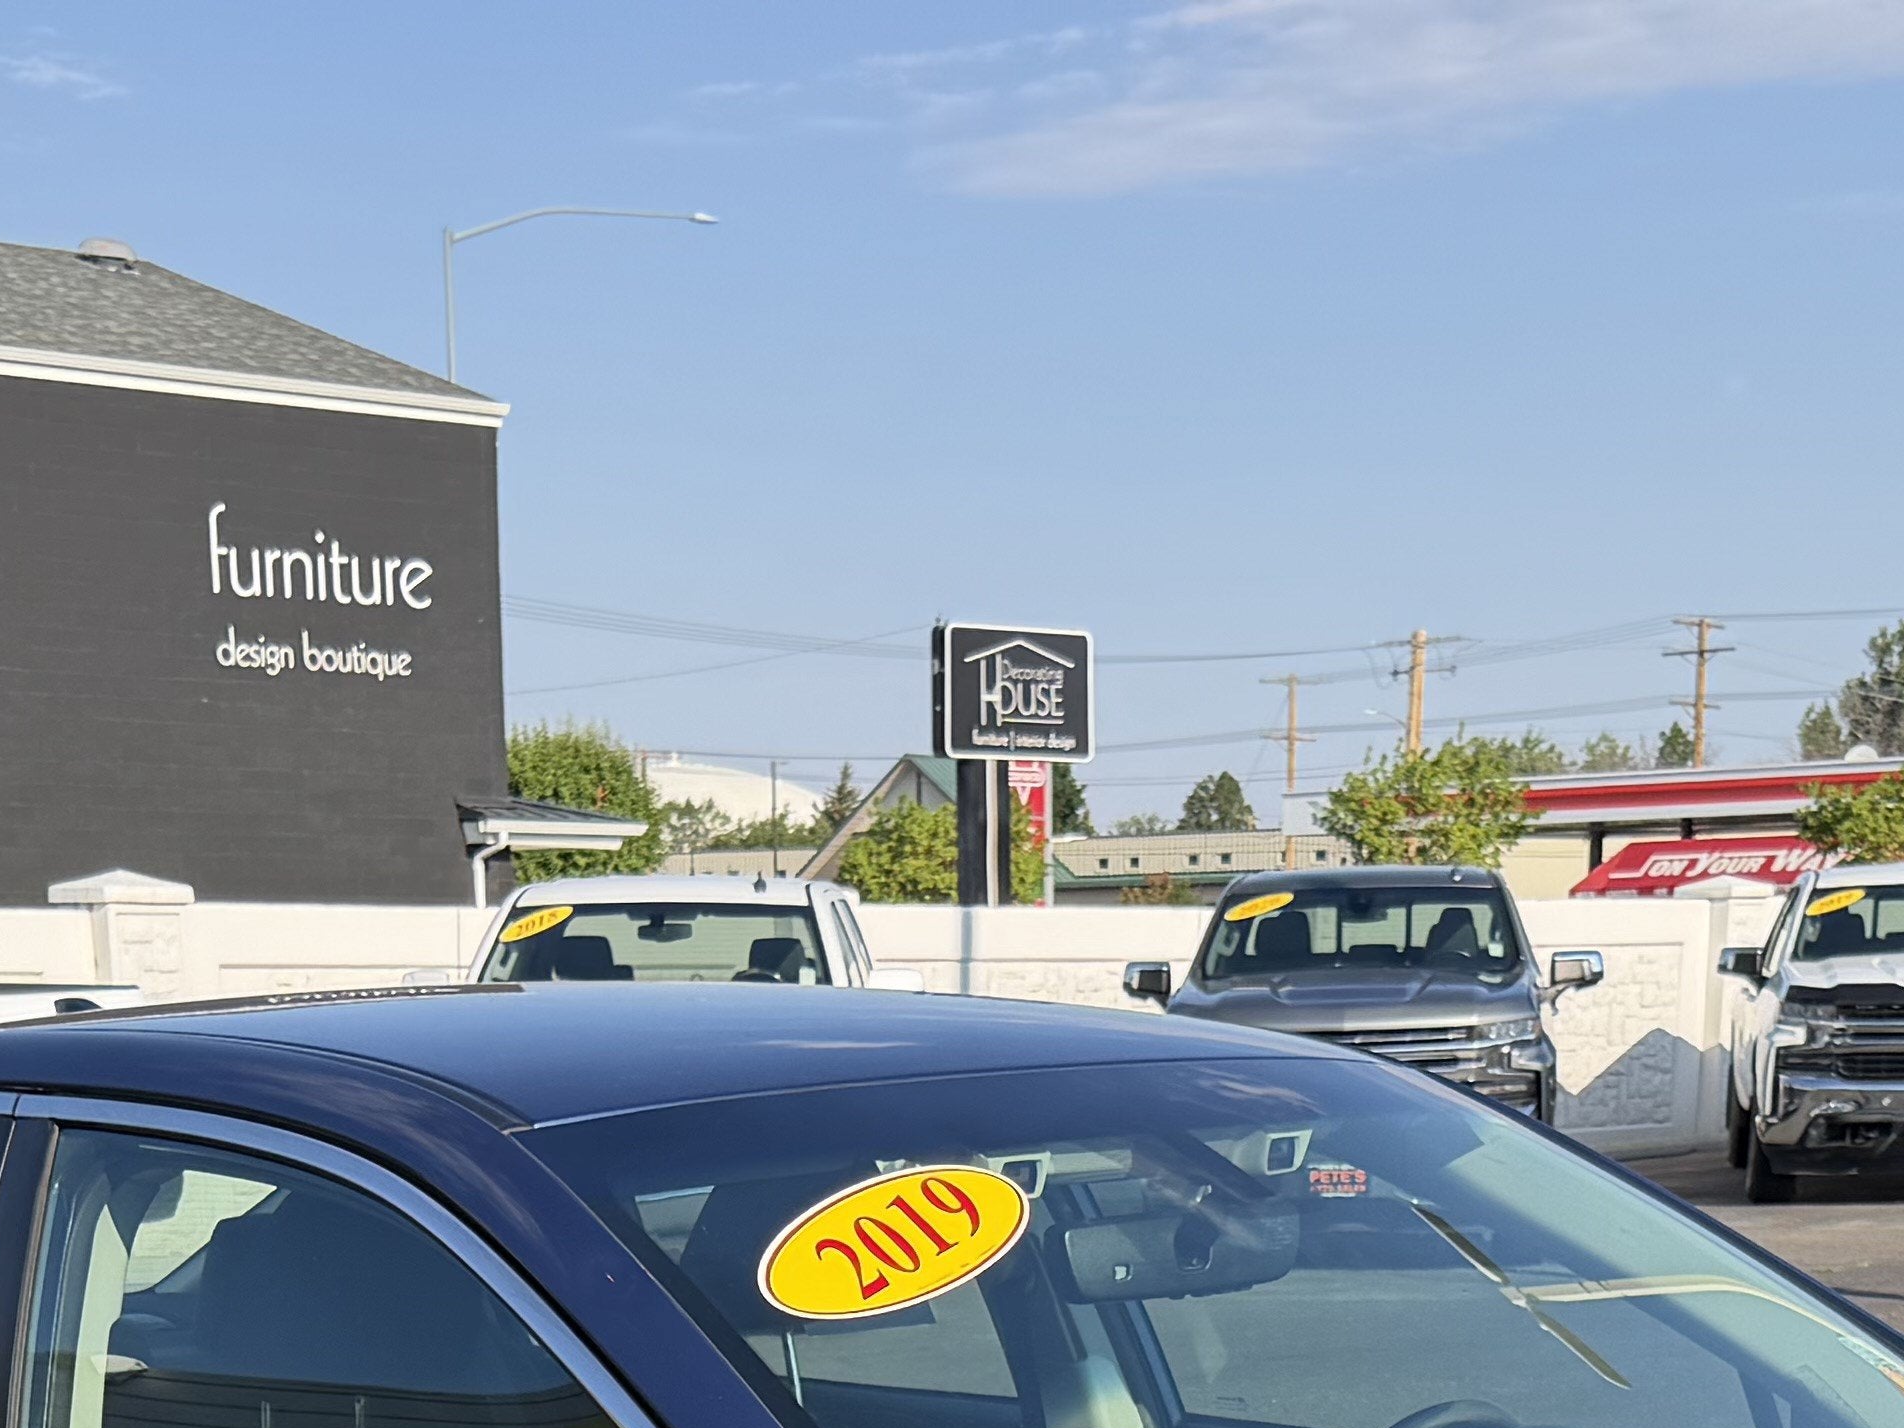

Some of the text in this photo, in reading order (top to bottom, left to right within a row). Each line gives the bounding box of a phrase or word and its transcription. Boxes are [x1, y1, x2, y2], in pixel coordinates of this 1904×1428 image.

[208, 501, 433, 609] furniture
[215, 623, 412, 682] design boutique
[979, 652, 1065, 727] HOUSE
[1647, 857, 1688, 877] ON
[1685, 852, 1766, 877] YOUR
[815, 1176, 981, 1300] 2019
